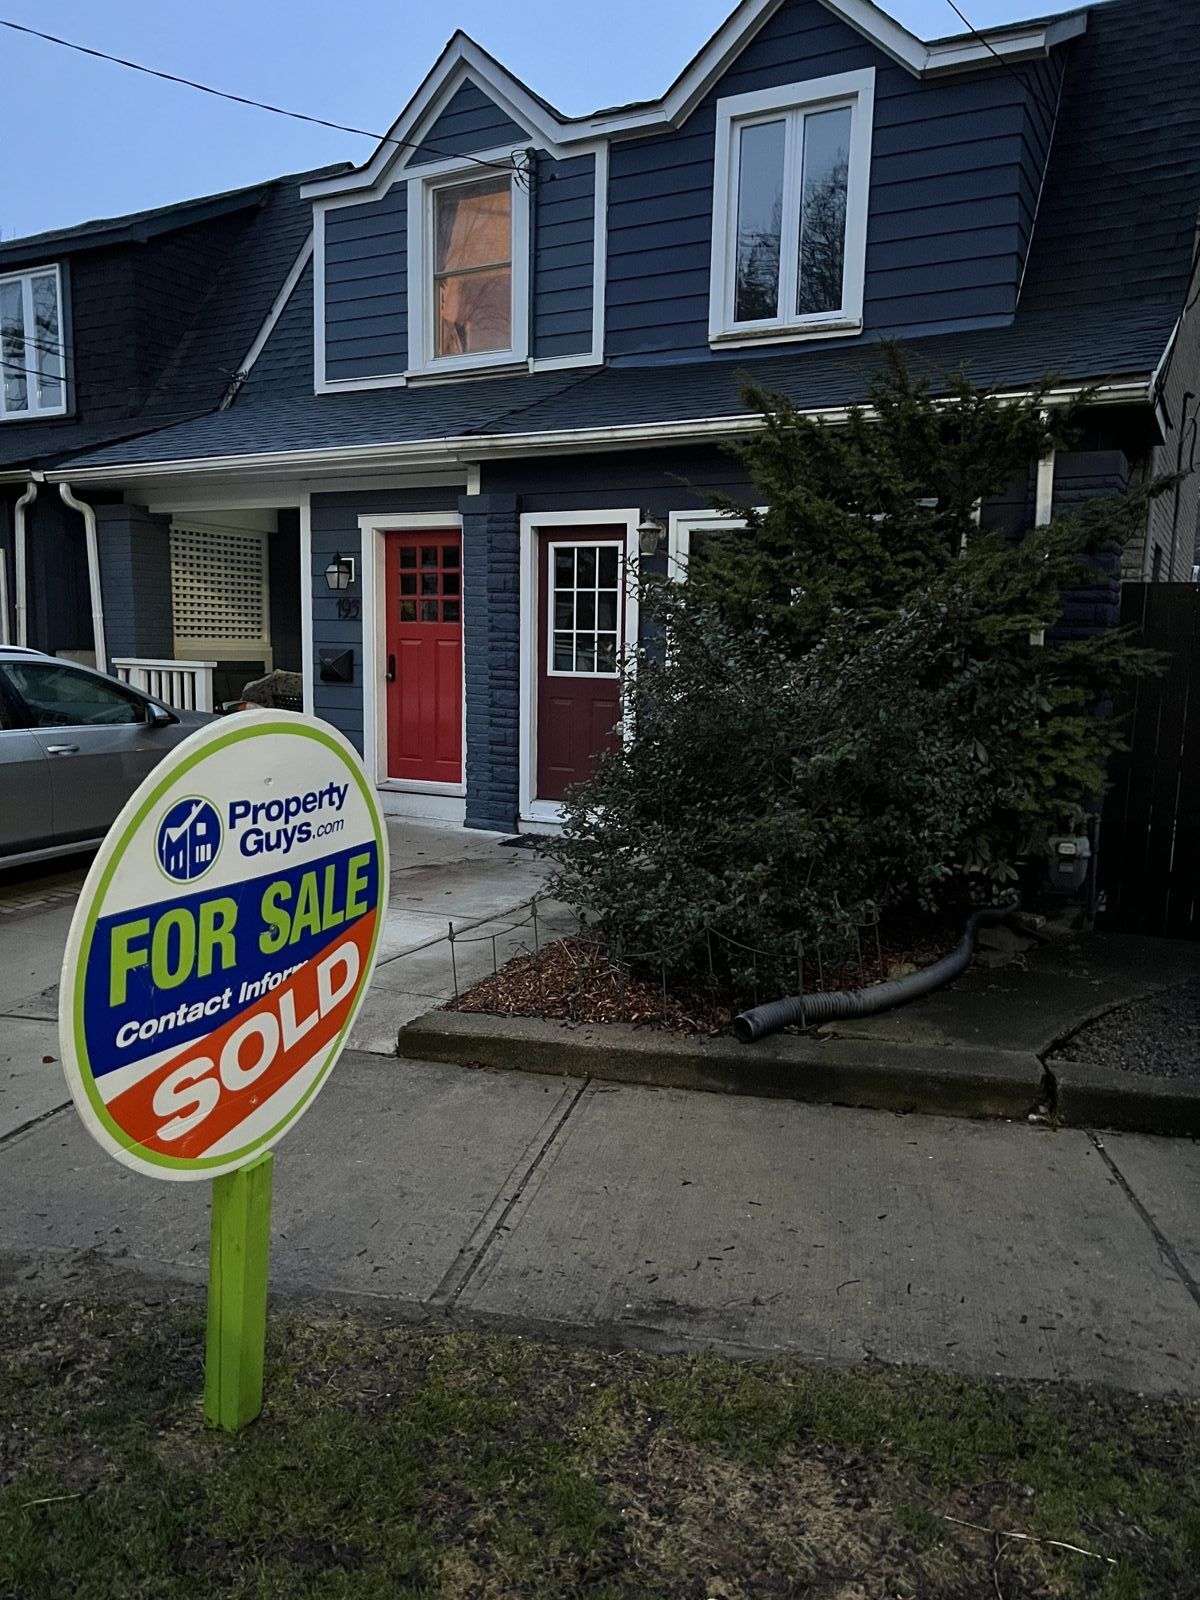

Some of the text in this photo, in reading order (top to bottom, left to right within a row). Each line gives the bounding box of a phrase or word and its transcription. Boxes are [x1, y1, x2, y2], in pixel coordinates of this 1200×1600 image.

[229, 782, 349, 829] Property
[240, 819, 344, 857] Guys.com
[110, 852, 370, 1007] FOR SALE
[116, 987, 233, 1048] Contact
[152, 941, 360, 1142] SOLD
